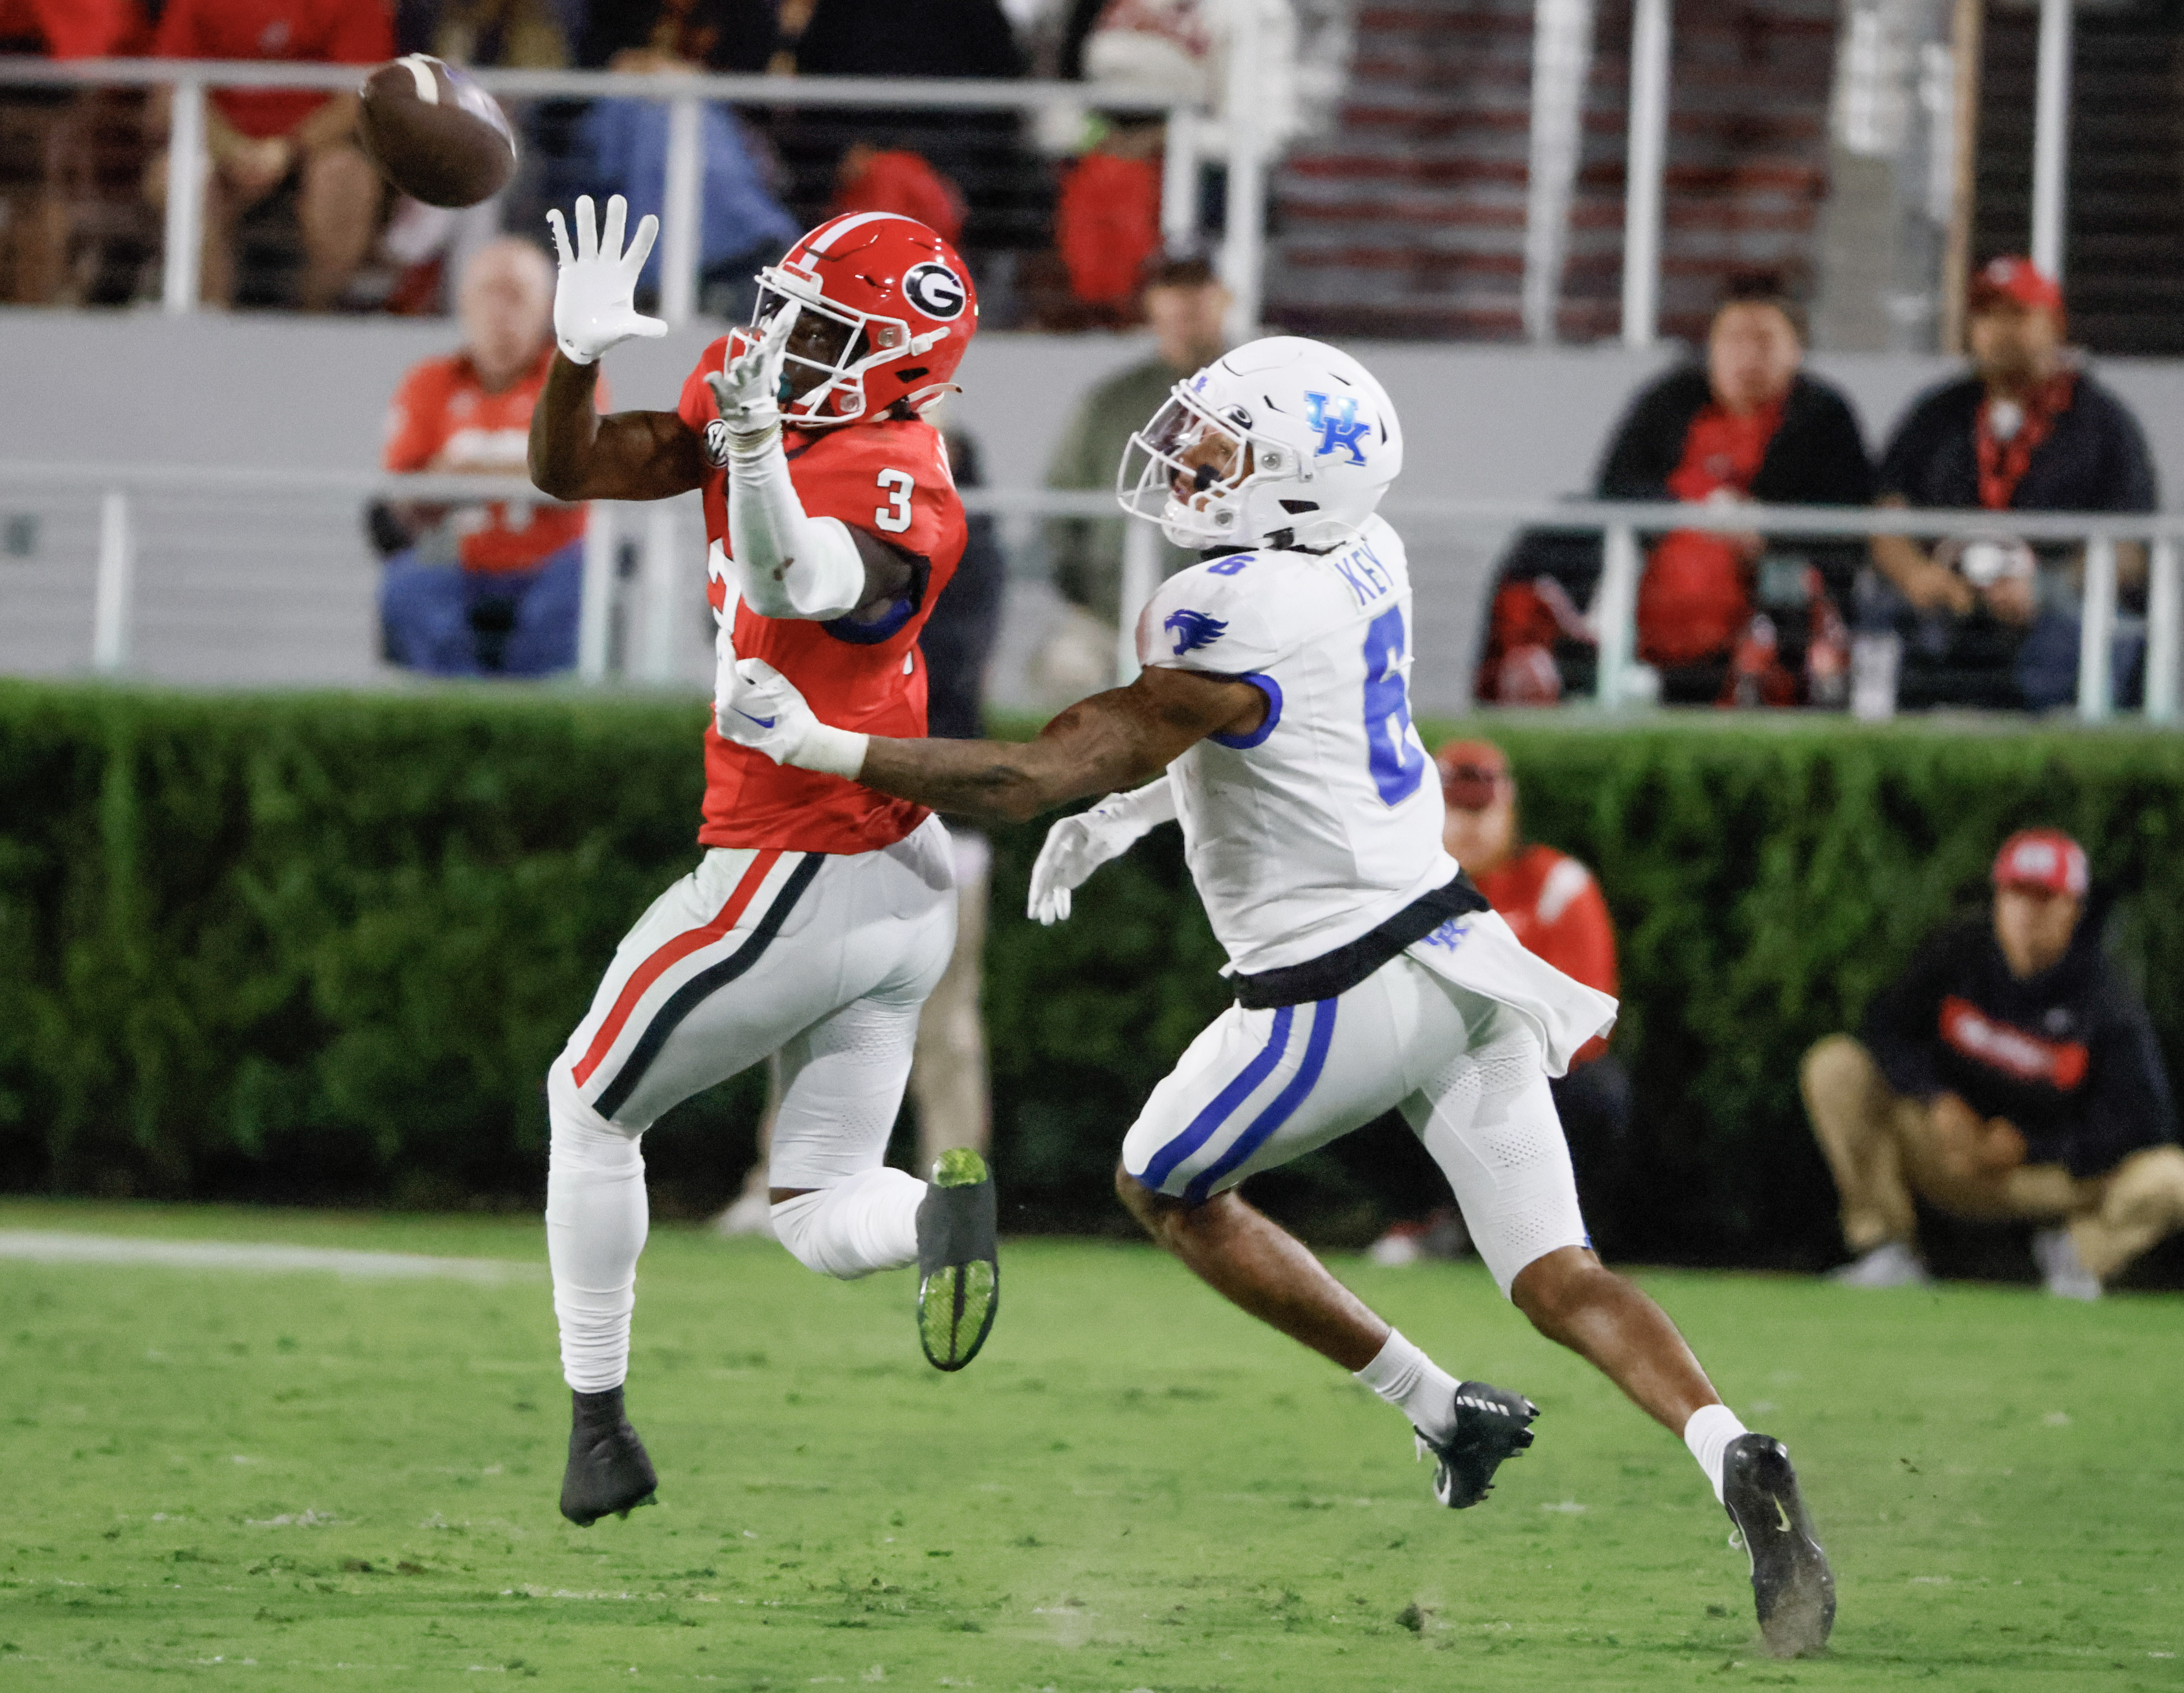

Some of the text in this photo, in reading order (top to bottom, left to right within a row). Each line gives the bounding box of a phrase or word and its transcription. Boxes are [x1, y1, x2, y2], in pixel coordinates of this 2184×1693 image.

[904, 262, 966, 320] G
[1304, 390, 1371, 466] UK
[875, 468, 915, 533] 3
[1207, 555, 1257, 576] 6
[1335, 542, 1394, 606] KEY
[1363, 604, 1424, 808] 6
